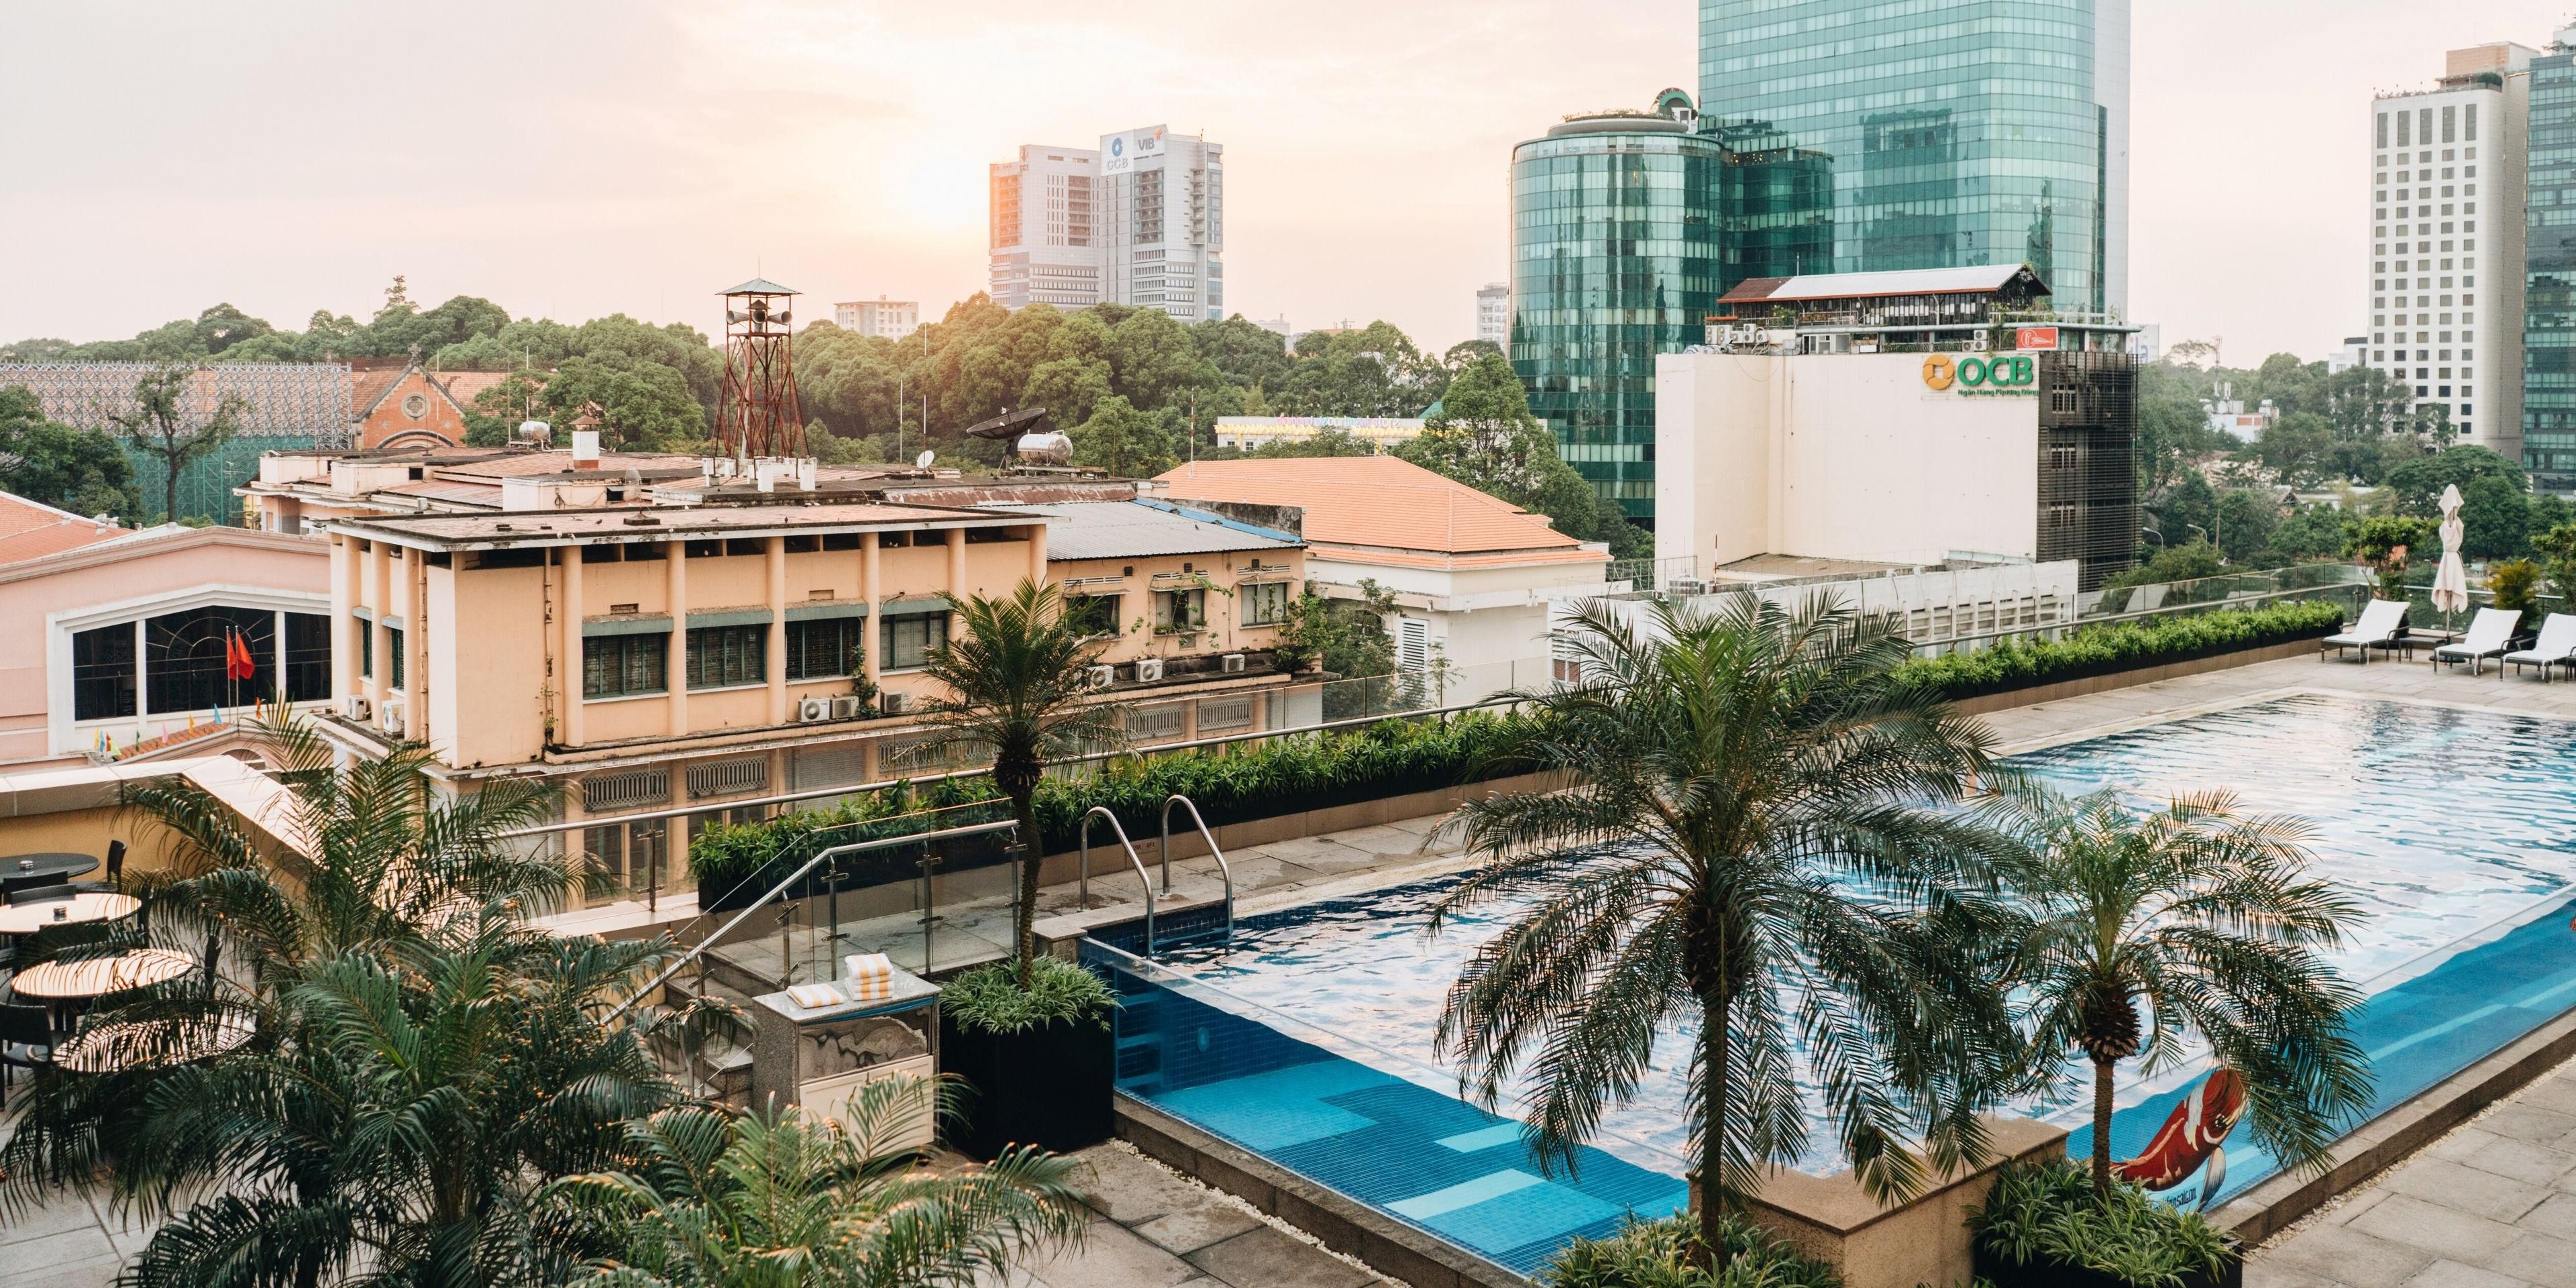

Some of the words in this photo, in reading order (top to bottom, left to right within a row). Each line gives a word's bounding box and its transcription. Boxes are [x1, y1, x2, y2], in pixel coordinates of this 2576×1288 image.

[1138, 138, 1155, 151] VIB
[1106, 158, 1128, 170] CCB
[1957, 356, 2034, 387] OCB
[1373, 415, 1400, 427] store
